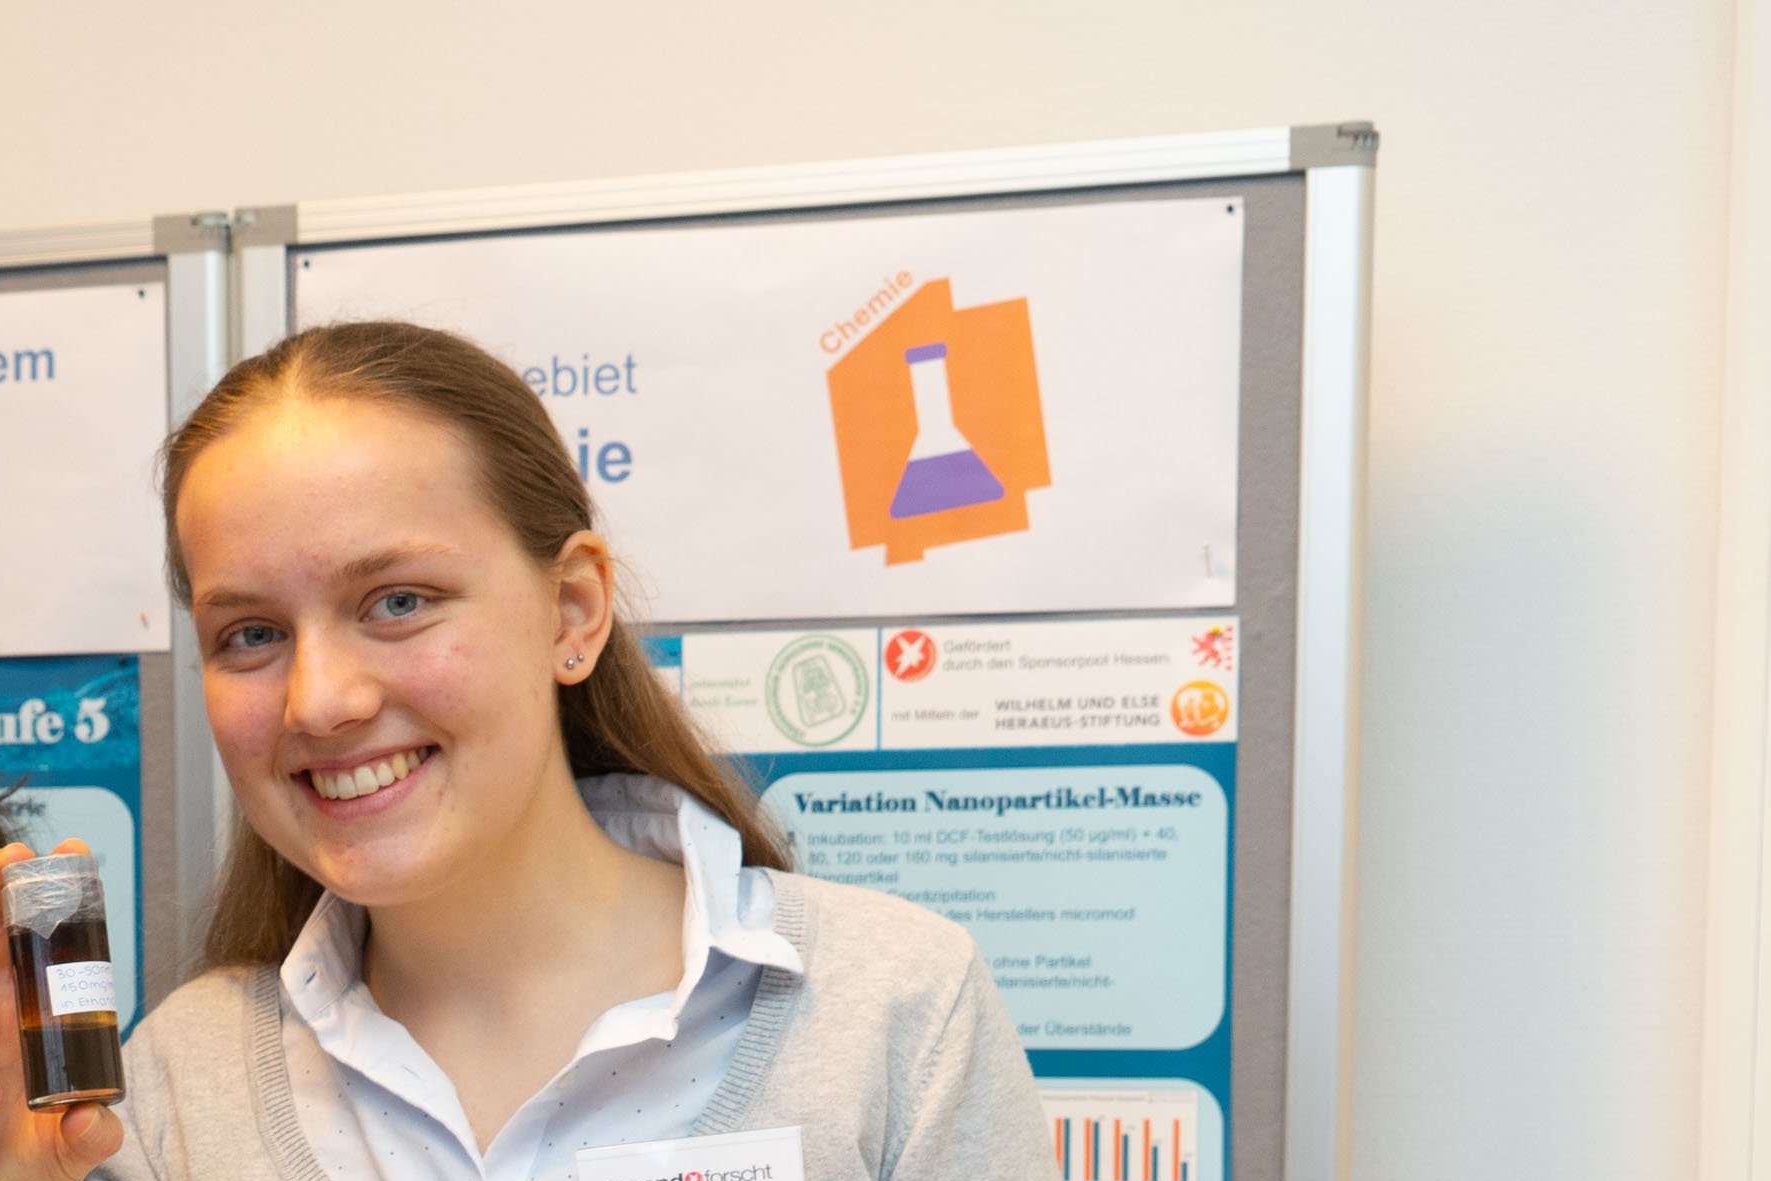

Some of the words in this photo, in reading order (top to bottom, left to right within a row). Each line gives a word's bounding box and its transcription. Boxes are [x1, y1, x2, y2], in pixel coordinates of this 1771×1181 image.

[820, 270, 914, 354] Chemie
[942, 639, 1012, 655] Gefördert
[942, 657, 983, 671] durch
[986, 656, 1015, 670] den
[1018, 655, 1109, 673] Sponsorpool
[994, 698, 1072, 713] WILHELM
[1077, 696, 1115, 710] UND
[1121, 695, 1160, 709] ELSE
[75, 697, 110, 744] 5
[891, 710, 912, 723] mit
[958, 708, 980, 721] der
[794, 791, 917, 814] Variation
[924, 786, 1202, 817] Nanopartikel-Masse
[893, 831, 910, 845] 10
[835, 850, 862, 865] 120
[865, 850, 899, 865] oder
[934, 853, 958, 867] mg
[992, 956, 1031, 969] ohne
[1034, 955, 1092, 969] Partikel
